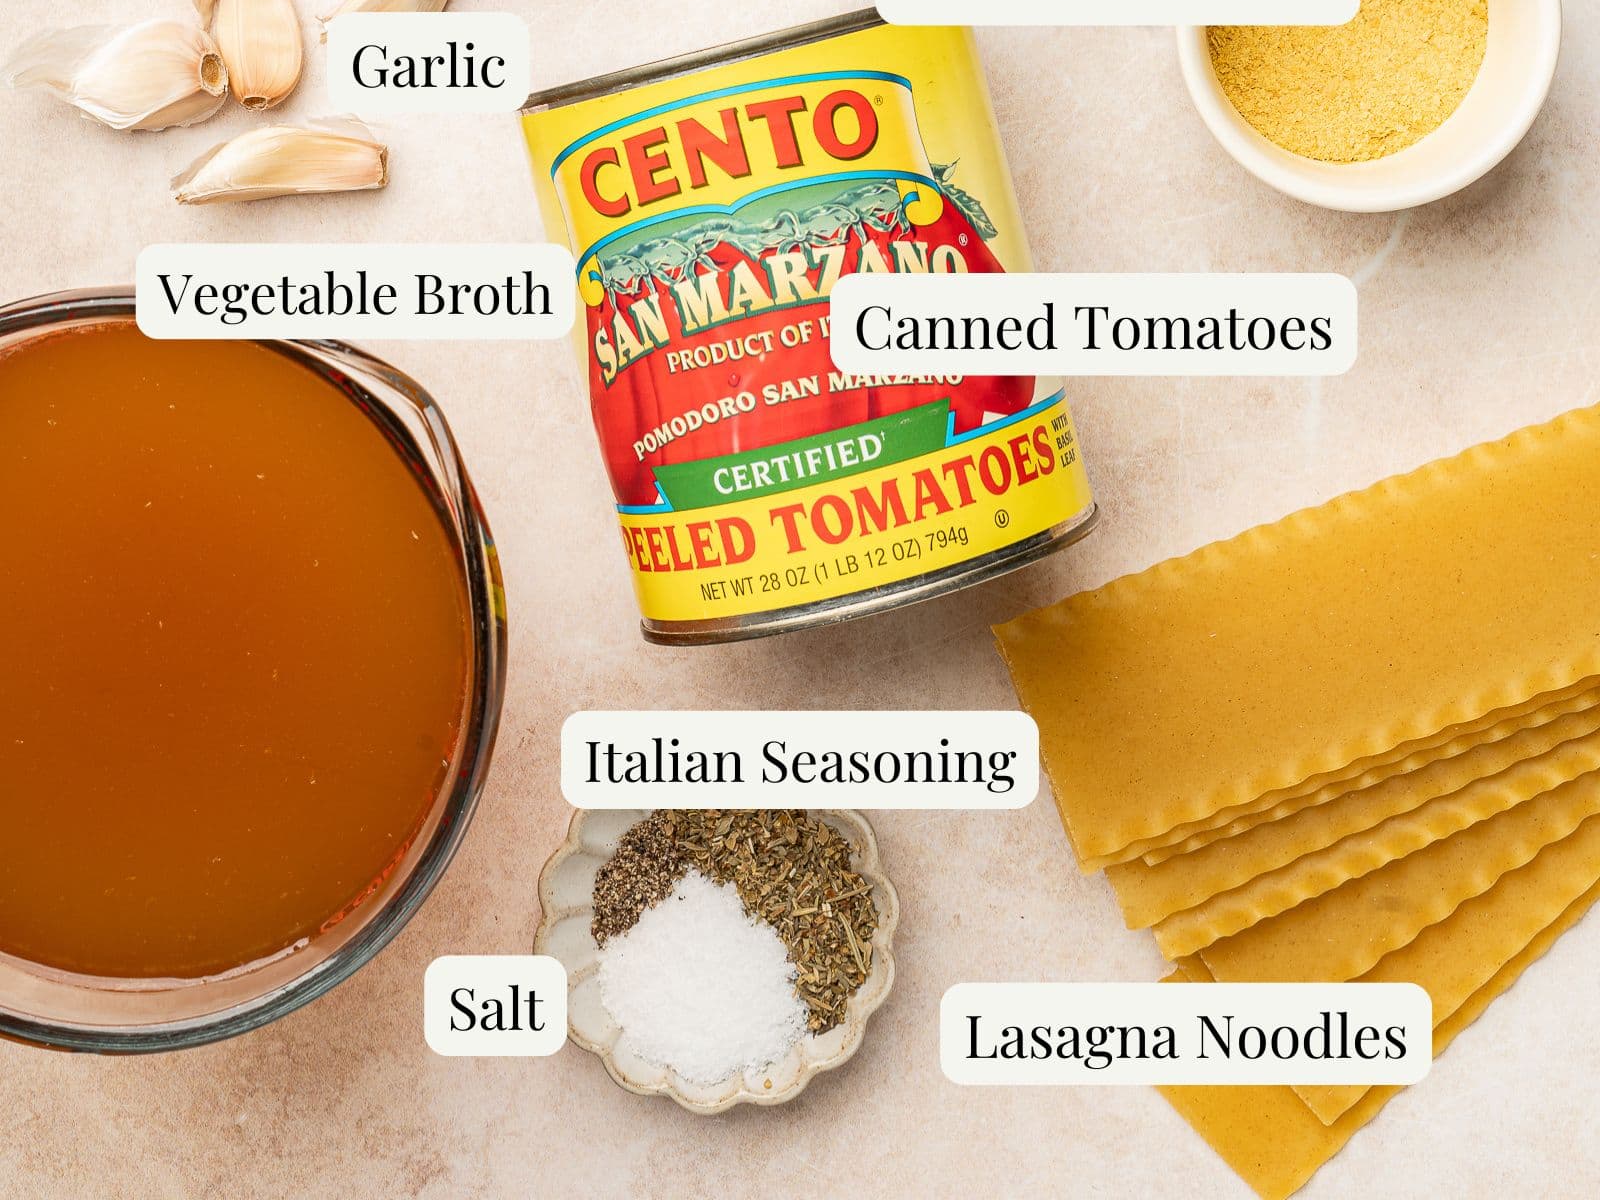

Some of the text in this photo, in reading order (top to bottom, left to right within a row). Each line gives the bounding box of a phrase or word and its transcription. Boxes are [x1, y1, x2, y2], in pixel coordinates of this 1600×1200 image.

[595, 293, 671, 387] SAN
[667, 330, 775, 374] PRODUCT
[779, 319, 813, 348] OF
[632, 390, 757, 462] POMODORO
[763, 373, 821, 406] SAN
[770, 425, 1057, 553] TOMATOES
[700, 525, 969, 601] NET WT 28 OZ (1 LB 12 OZ) 794g
